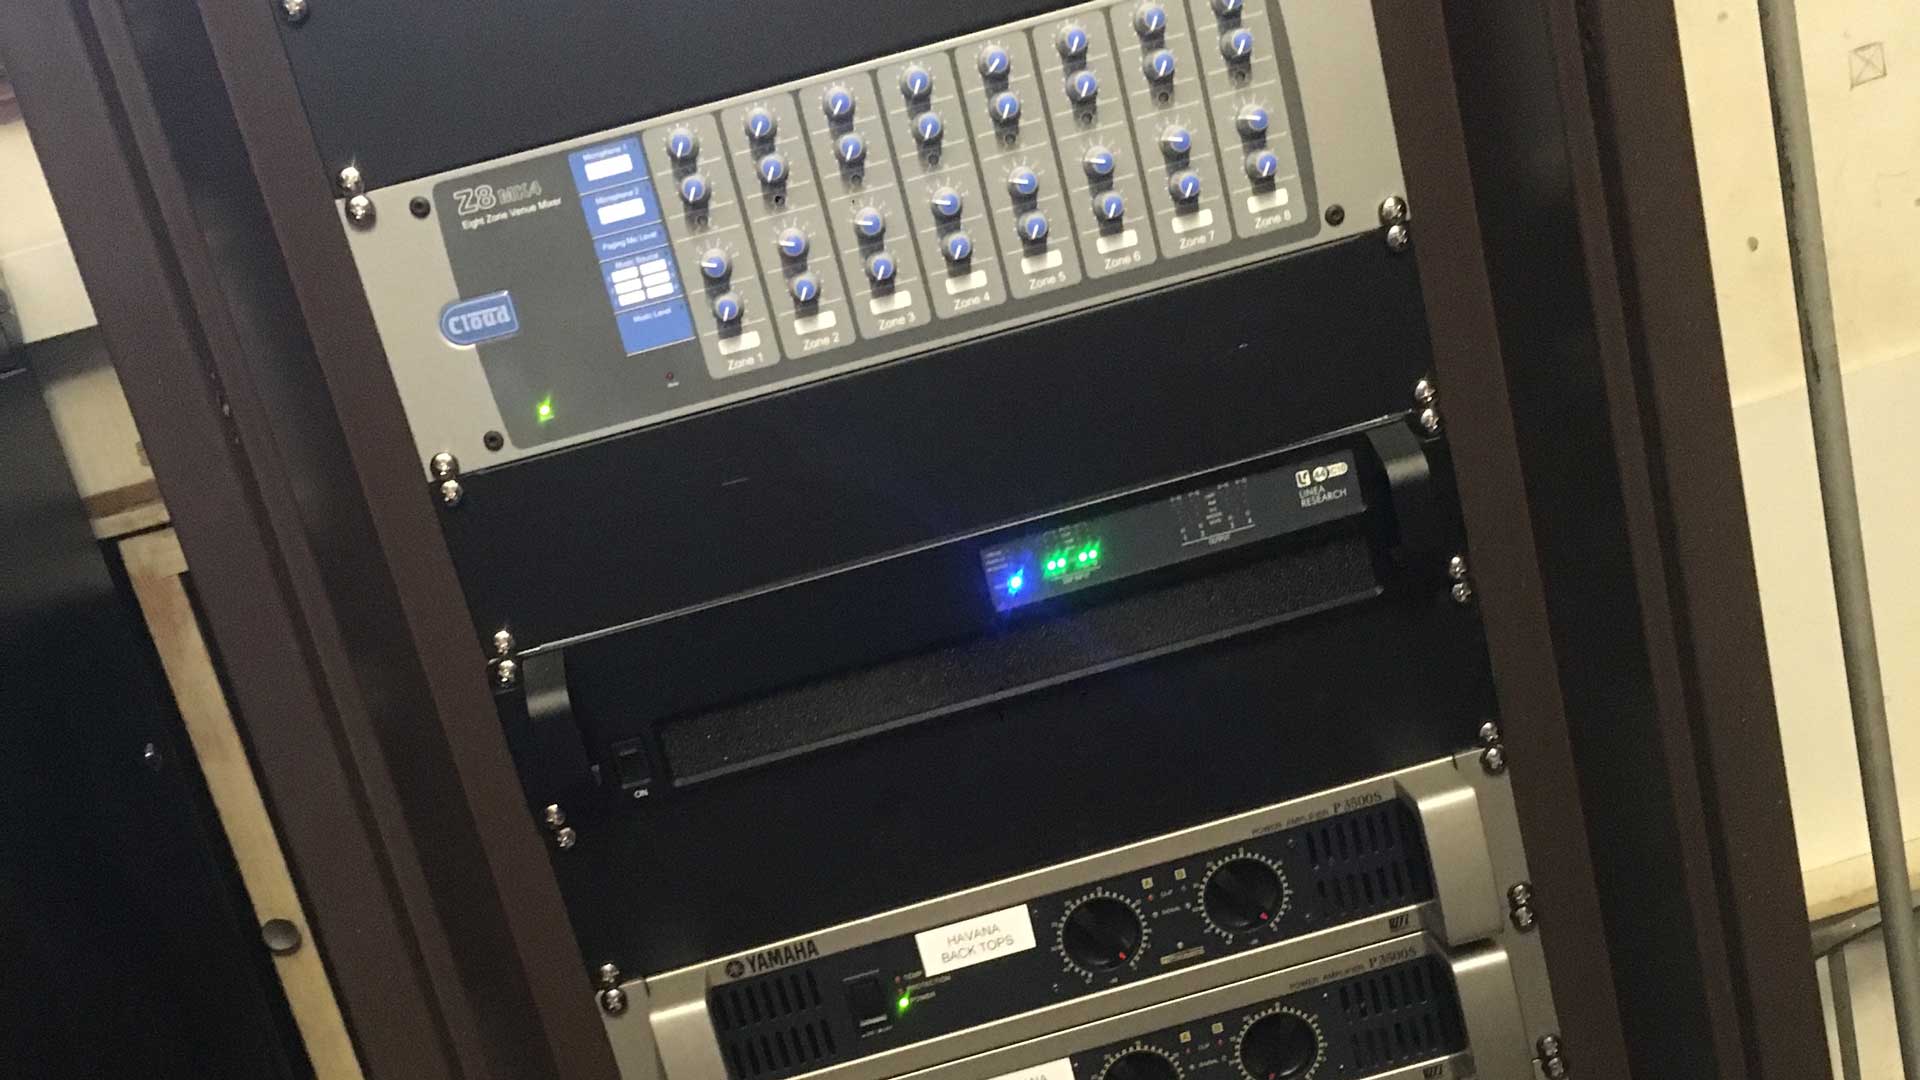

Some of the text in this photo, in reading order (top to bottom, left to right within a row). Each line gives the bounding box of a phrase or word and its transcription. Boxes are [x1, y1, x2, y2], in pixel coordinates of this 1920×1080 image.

[453, 185, 497, 215] Z8
[461, 197, 562, 230] Eight Zone Venue Mixer
[1255, 209, 1292, 229] Zone 8
[1179, 230, 1216, 250] Zone 7
[1104, 250, 1142, 270] Zone 6
[1029, 271, 1067, 291] Zone 5
[954, 291, 991, 311] Zone 4
[448, 304, 511, 335] Cloud
[879, 311, 917, 331] Zone 3
[803, 331, 841, 351] Zone 2
[728, 352, 764, 371] Zone 1
[1301, 488, 1347, 508] RESEARCH
[633, 787, 649, 799] ON
[946, 923, 1001, 945] HAVANA
[745, 939, 820, 974] YAMAHA
[940, 934, 1015, 964] BACK TOPS
